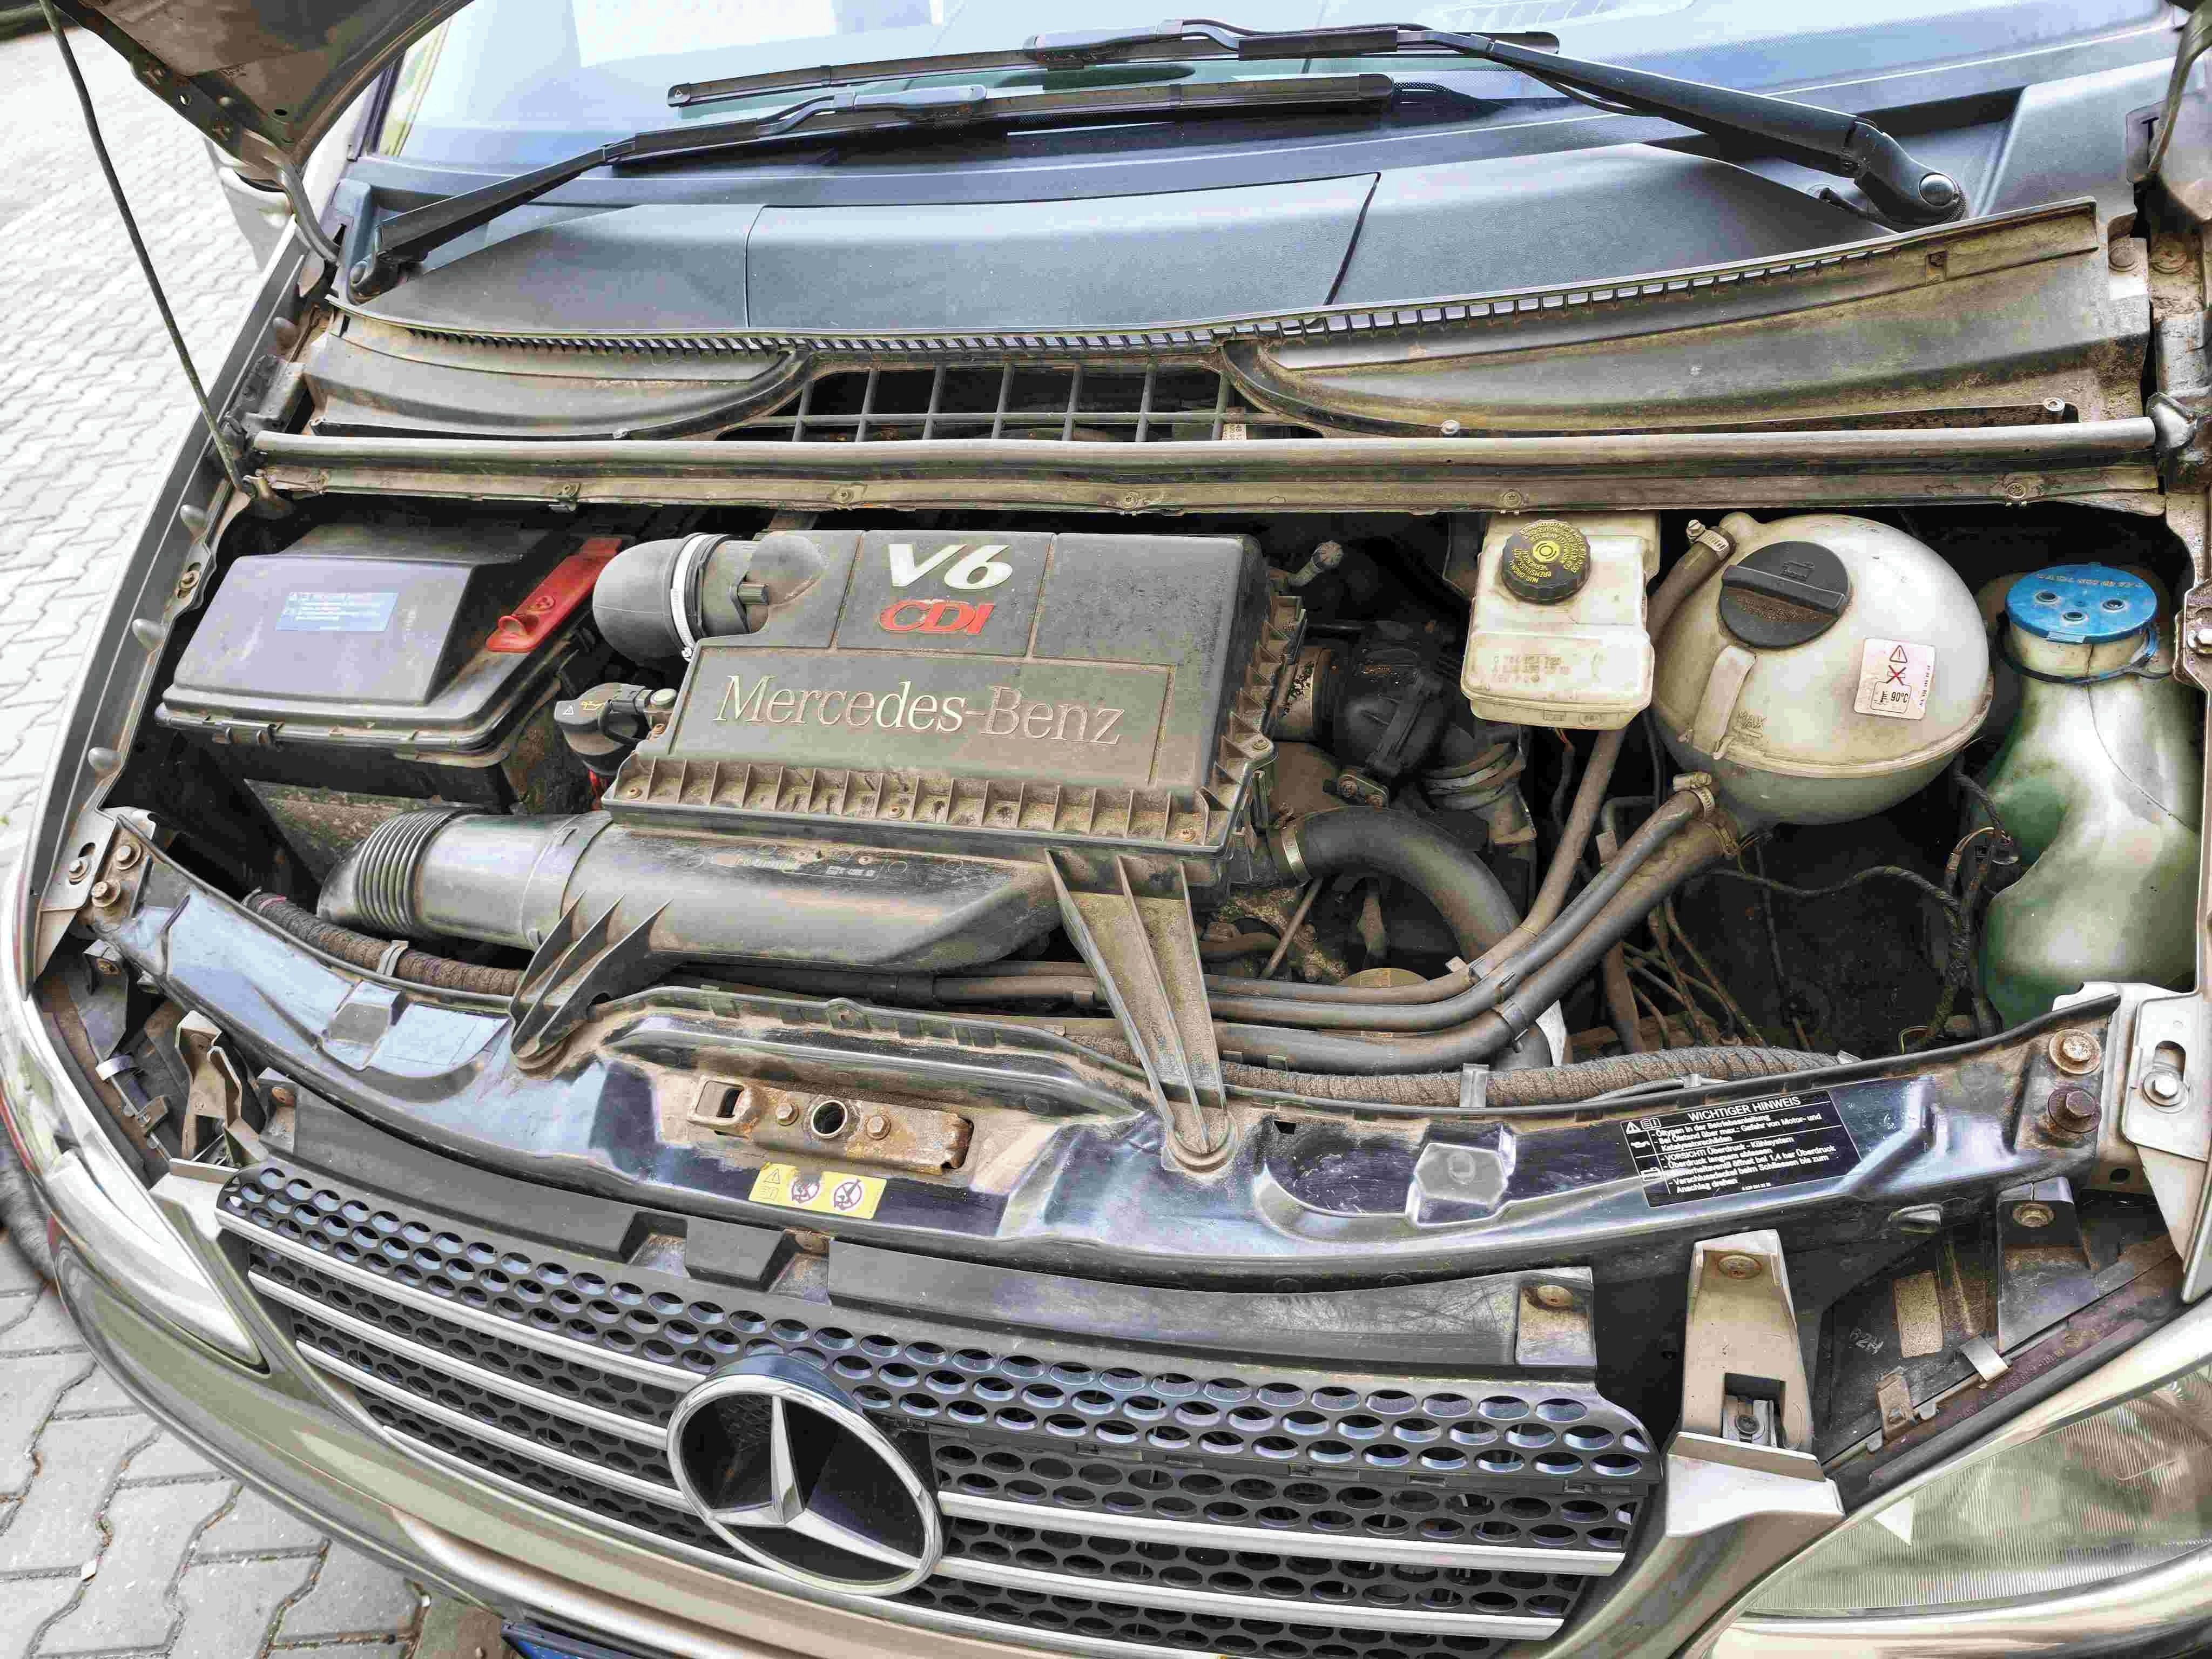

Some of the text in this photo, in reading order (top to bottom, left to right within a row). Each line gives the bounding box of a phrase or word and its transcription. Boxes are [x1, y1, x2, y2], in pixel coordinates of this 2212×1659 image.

[888, 543, 1014, 590] V6
[878, 598, 995, 636] CDI
[1890, 691, 1908, 703] 90°C
[713, 675, 1126, 746] Mercedes-Benz
[1737, 710, 1766, 728] MAX
[1688, 1097, 1800, 1122] WICHTIGER HINWEIS
[1741, 1123, 1765, 1131] Gefahr
[1781, 1117, 1806, 1125] Motor-
[1807, 1113, 1822, 1121] und
[1708, 1115, 1770, 1130] Betriebsanleitung
[1665, 1150, 1707, 1162] VORSICHT!
[1707, 1144, 1746, 1155] Überdruck
[1751, 1137, 1795, 1148] Kühlsystem
[1668, 1158, 1707, 1169] Überdruck
[1708, 1154, 1739, 1164] langsam
[1740, 1149, 1772, 1157] ablassen
[1671, 1162, 1732, 1176] herheitsventil
[1732, 1159, 1755, 1167] öffnet
[1769, 1154, 1782, 1162] 1,4
[1796, 1145, 1836, 1157] Überdruck
[1673, 1169, 1738, 1186] Verschlussdeckel
[1738, 1166, 1758, 1175] beim
[1758, 1159, 1799, 1171] Schliessen
[1677, 1182, 1711, 1193] Anschlag
[1711, 1178, 1738, 1188] drehen
